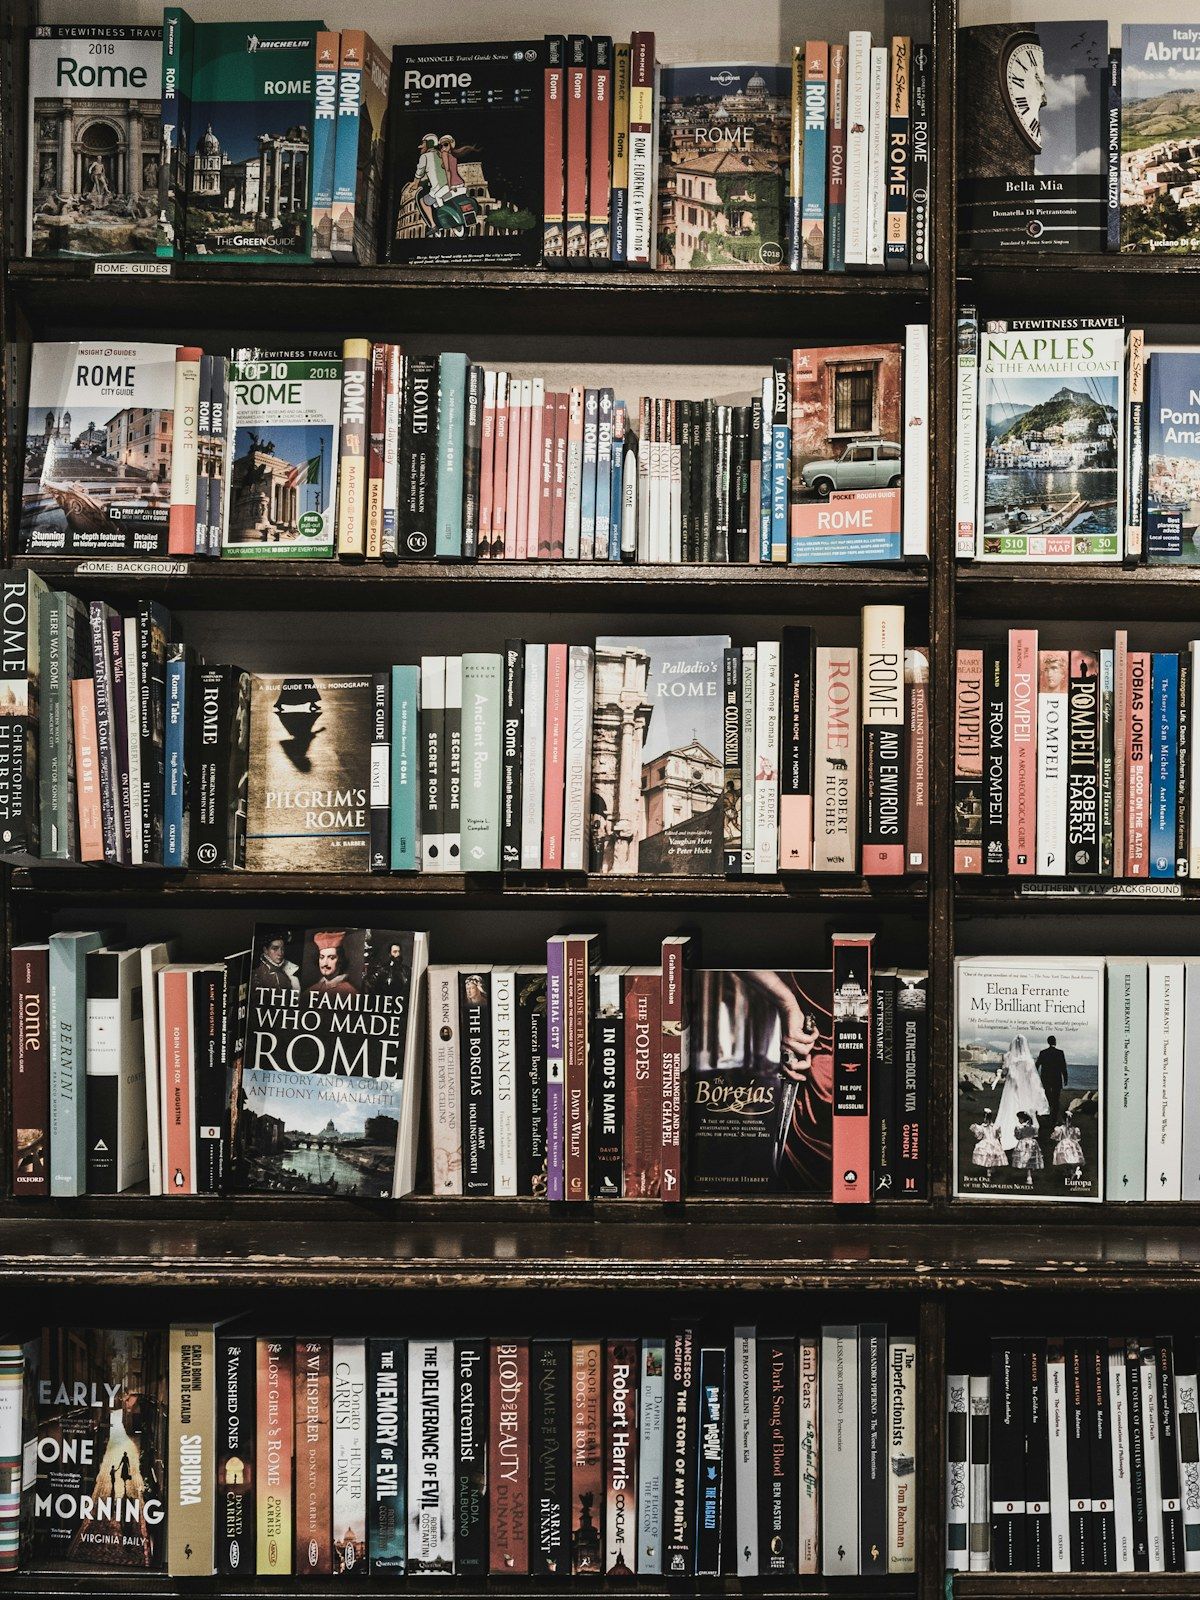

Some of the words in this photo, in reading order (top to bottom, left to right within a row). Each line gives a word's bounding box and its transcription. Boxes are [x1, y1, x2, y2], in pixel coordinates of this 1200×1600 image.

[89, 43, 114, 55] 2018
[260, 38, 309, 48] MICHELIN
[1173, 29, 1200, 41] Italy:
[57, 57, 147, 87] Rome
[404, 70, 471, 88] Rome
[550, 73, 558, 99] Rome
[264, 80, 311, 95] ROME
[316, 73, 334, 120] ROME
[806, 84, 826, 130] ROME
[695, 128, 754, 142] ROME
[890, 134, 906, 196] ROME
[1006, 180, 1036, 191] Bella
[1041, 180, 1063, 190] Mia
[762, 250, 780, 258] 2018
[96, 264, 128, 273] ROME:
[132, 264, 168, 274] GUIDES
[1013, 320, 1078, 329] EYEWITNESS
[1080, 319, 1119, 328] TRAVEL
[987, 338, 1094, 360] NAPLES
[77, 366, 136, 387] ROME
[310, 369, 337, 379] 2018
[101, 388, 115, 396] CITY
[342, 371, 366, 425] ROME
[412, 378, 428, 434] ROME
[776, 373, 785, 413] MOON
[774, 432, 785, 471] ROME
[774, 476, 785, 519] WALKS
[818, 510, 873, 530] ROME
[82, 563, 113, 573] ROME:
[117, 563, 186, 573] BACKGROUND
[3, 582, 25, 672] ROME
[661, 662, 717, 675] Palladio's
[656, 681, 717, 698] ROME
[868, 653, 897, 719] ROME
[202, 687, 218, 744] ROME
[828, 660, 850, 750] ROME
[958, 679, 980, 758] POMPEII
[1071, 682, 1094, 766] POMPEII
[266, 789, 366, 809] PILGRIM'S
[1070, 774, 1082, 844] HARRIS
[1082, 774, 1094, 844] ROBERT
[305, 812, 365, 828] ROME
[255, 988, 299, 1005] THE
[309, 992, 404, 1017] FAMILIES
[498, 979, 510, 1022] POPE
[986, 983, 1017, 997] Elena
[1021, 984, 1069, 998] Ferrante
[971, 998, 991, 1014] My
[994, 998, 1041, 1014] Brilliant
[1044, 1000, 1086, 1014] Friend
[256, 1009, 320, 1030] WHO
[329, 1013, 400, 1038] MADE
[603, 1028, 615, 1043] IN
[60, 1021, 72, 1100] BERNINI
[253, 1032, 400, 1079] ROME
[497, 1028, 510, 1102] FRANCIS
[603, 1048, 616, 1088] GOD'S
[695, 1081, 774, 1113] Borgias
[603, 1094, 615, 1134] NAME
[381, 1351, 393, 1369] THE
[461, 1351, 480, 1378] the
[38, 1380, 121, 1408] EARLY
[307, 1355, 320, 1444] WHISPERER
[613, 1364, 629, 1428] Robert
[677, 1390, 687, 1413] THE
[376, 1372, 398, 1447] MEMORY
[461, 1381, 479, 1462] extremist
[676, 1417, 686, 1455] STORY
[37, 1438, 93, 1465] ONE
[381, 1448, 392, 1461] OF
[613, 1433, 629, 1490] Harris
[180, 1434, 201, 1506] SUBURRA
[675, 1458, 685, 1475] OF
[376, 1463, 398, 1501] EVIL
[674, 1479, 685, 1497] MY
[34, 1495, 164, 1524] MORNING
[615, 1494, 625, 1544] CONCLAVE
[673, 1500, 687, 1543] PURITY
[81, 1534, 119, 1545] VIRGINIA
[122, 1536, 147, 1546] BAILY
